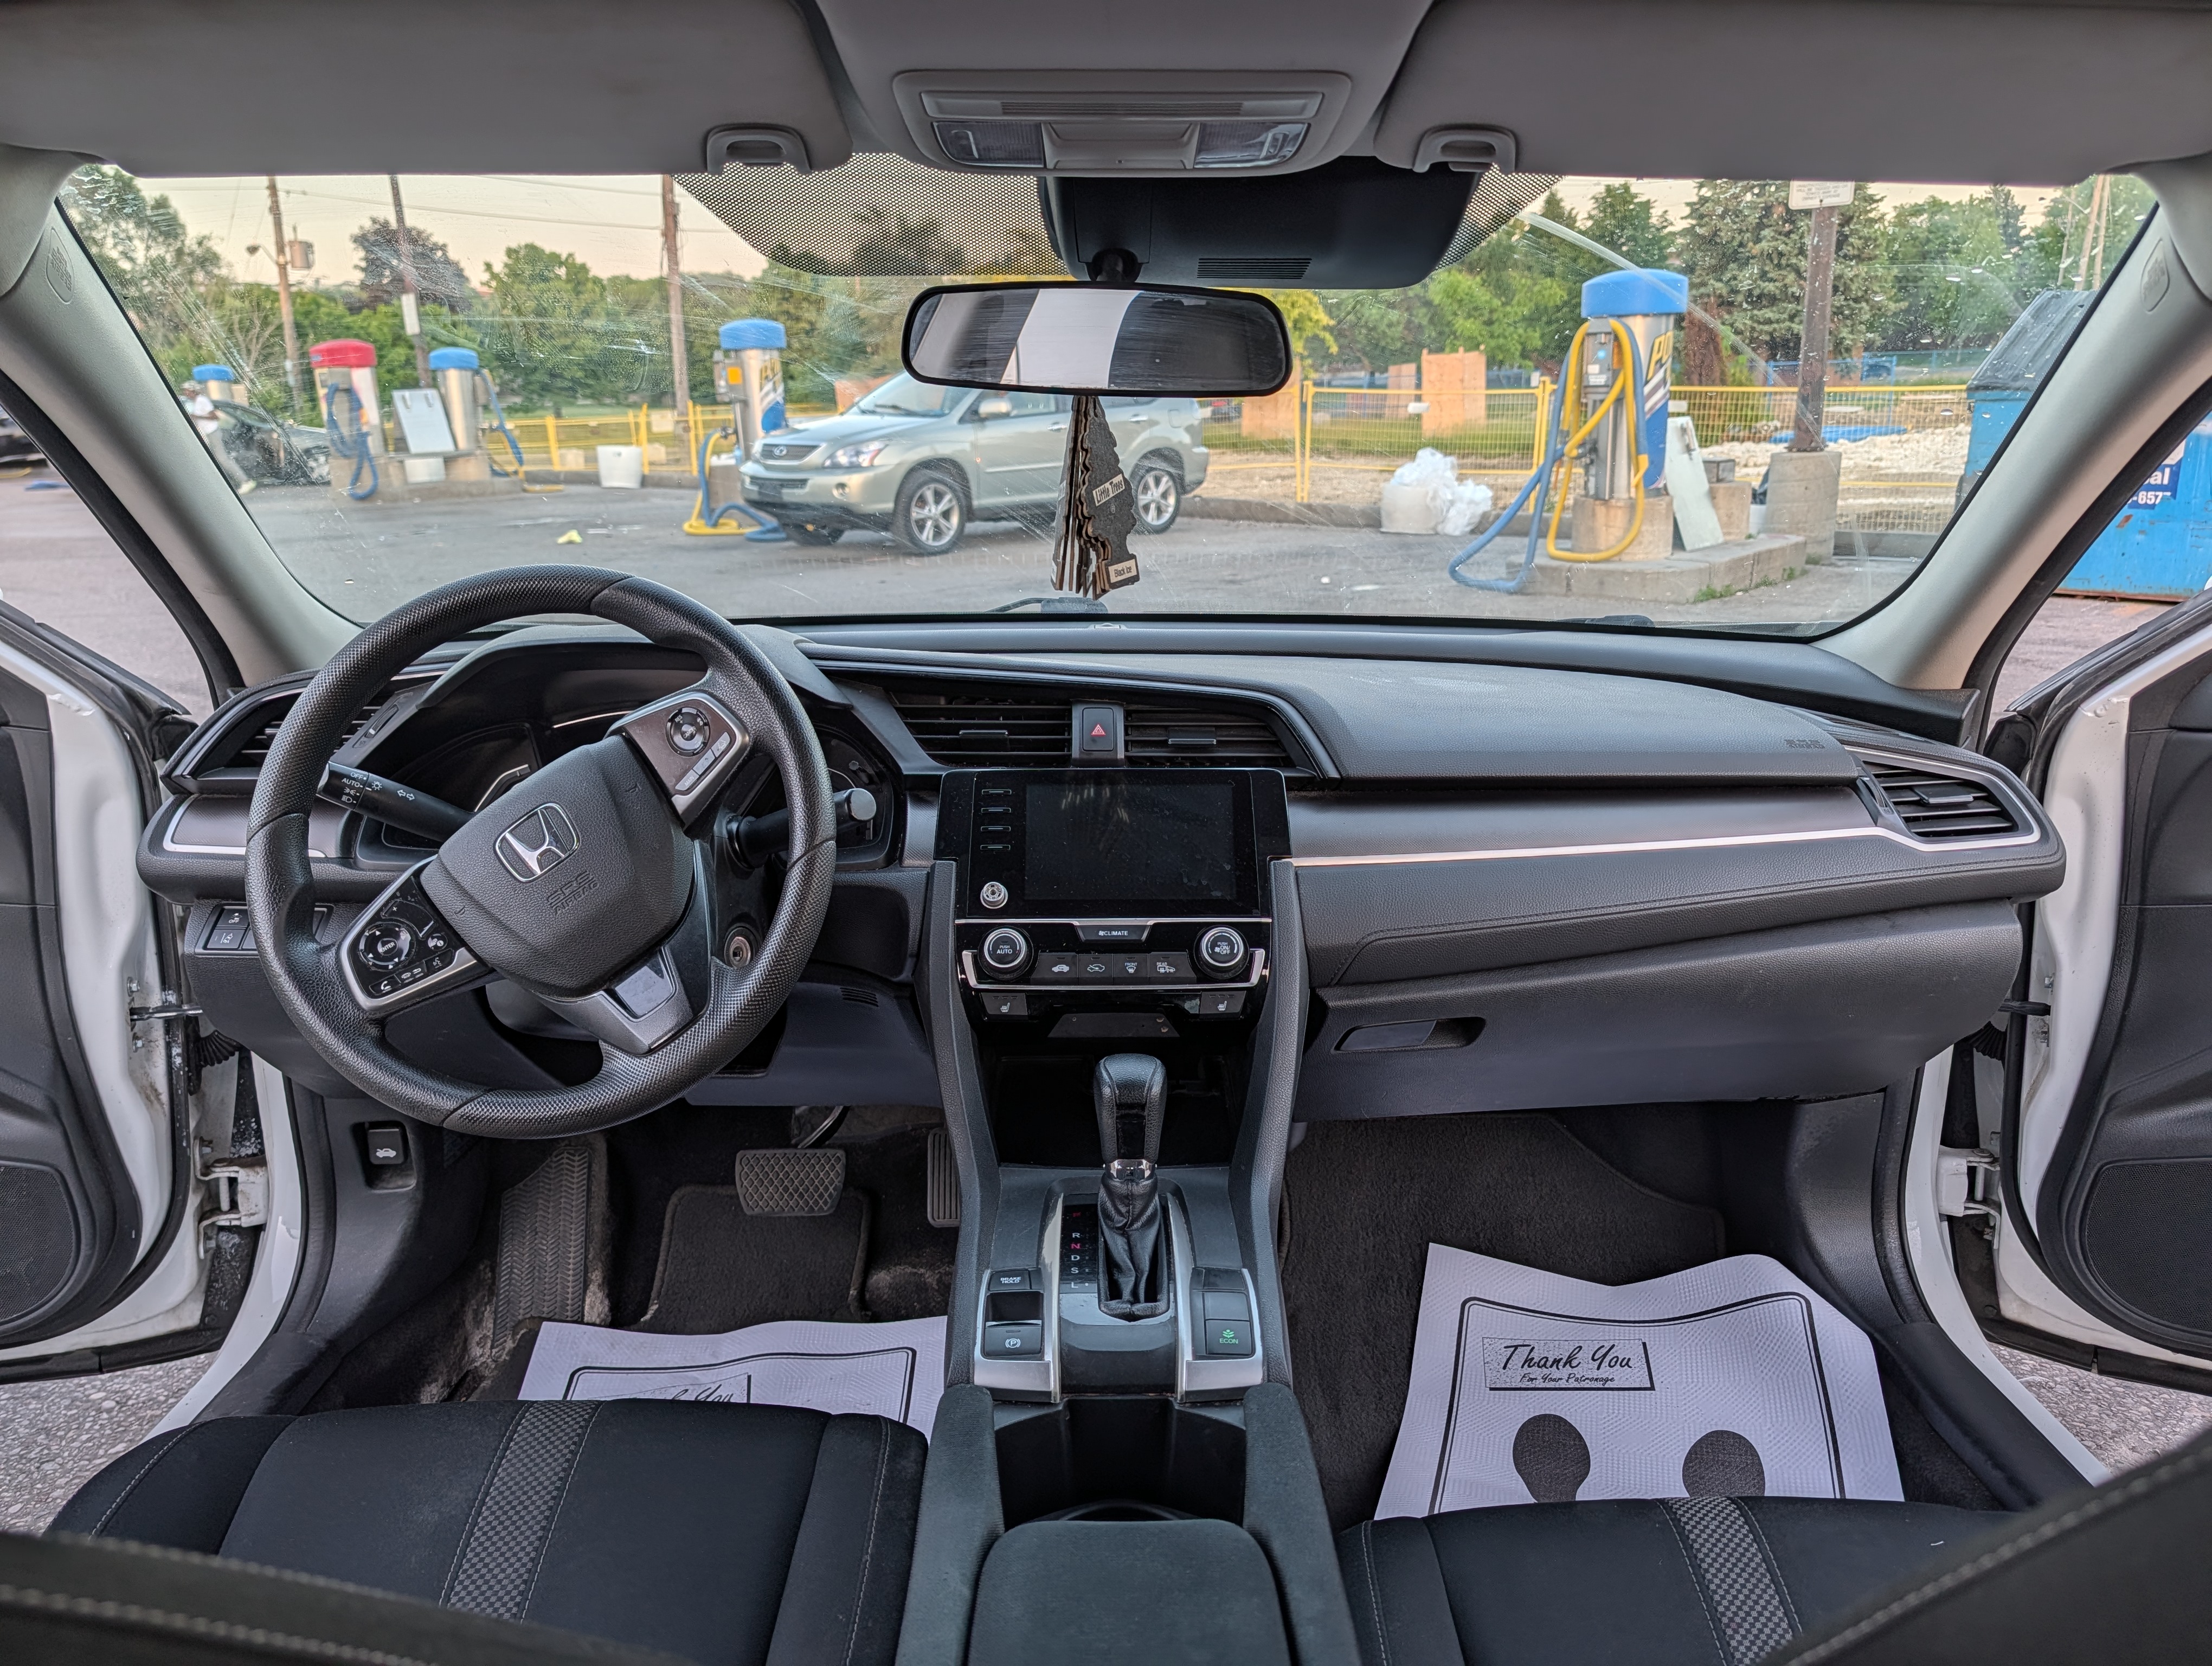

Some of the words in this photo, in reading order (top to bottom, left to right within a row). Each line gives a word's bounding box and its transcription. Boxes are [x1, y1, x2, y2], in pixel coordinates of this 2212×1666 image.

[2143, 467, 2171, 485] al
[1095, 485, 1110, 504] Little
[1109, 479, 1123, 495] Trees
[1114, 567, 1125, 578] Black
[674, 714, 683, 722] RES
[341, 778, 361, 787] AUTO
[684, 776, 695, 786] MAIN
[547, 870, 590, 906] SRS
[555, 879, 599, 915] AIRBAG
[380, 941, 395, 953] ENTER
[1502, 1344, 1583, 1370] Thank
[1591, 1344, 1633, 1370] You
[1520, 1373, 1538, 1383] For
[1541, 1373, 1562, 1383] Your
[1566, 1373, 1615, 1387] Patronage
